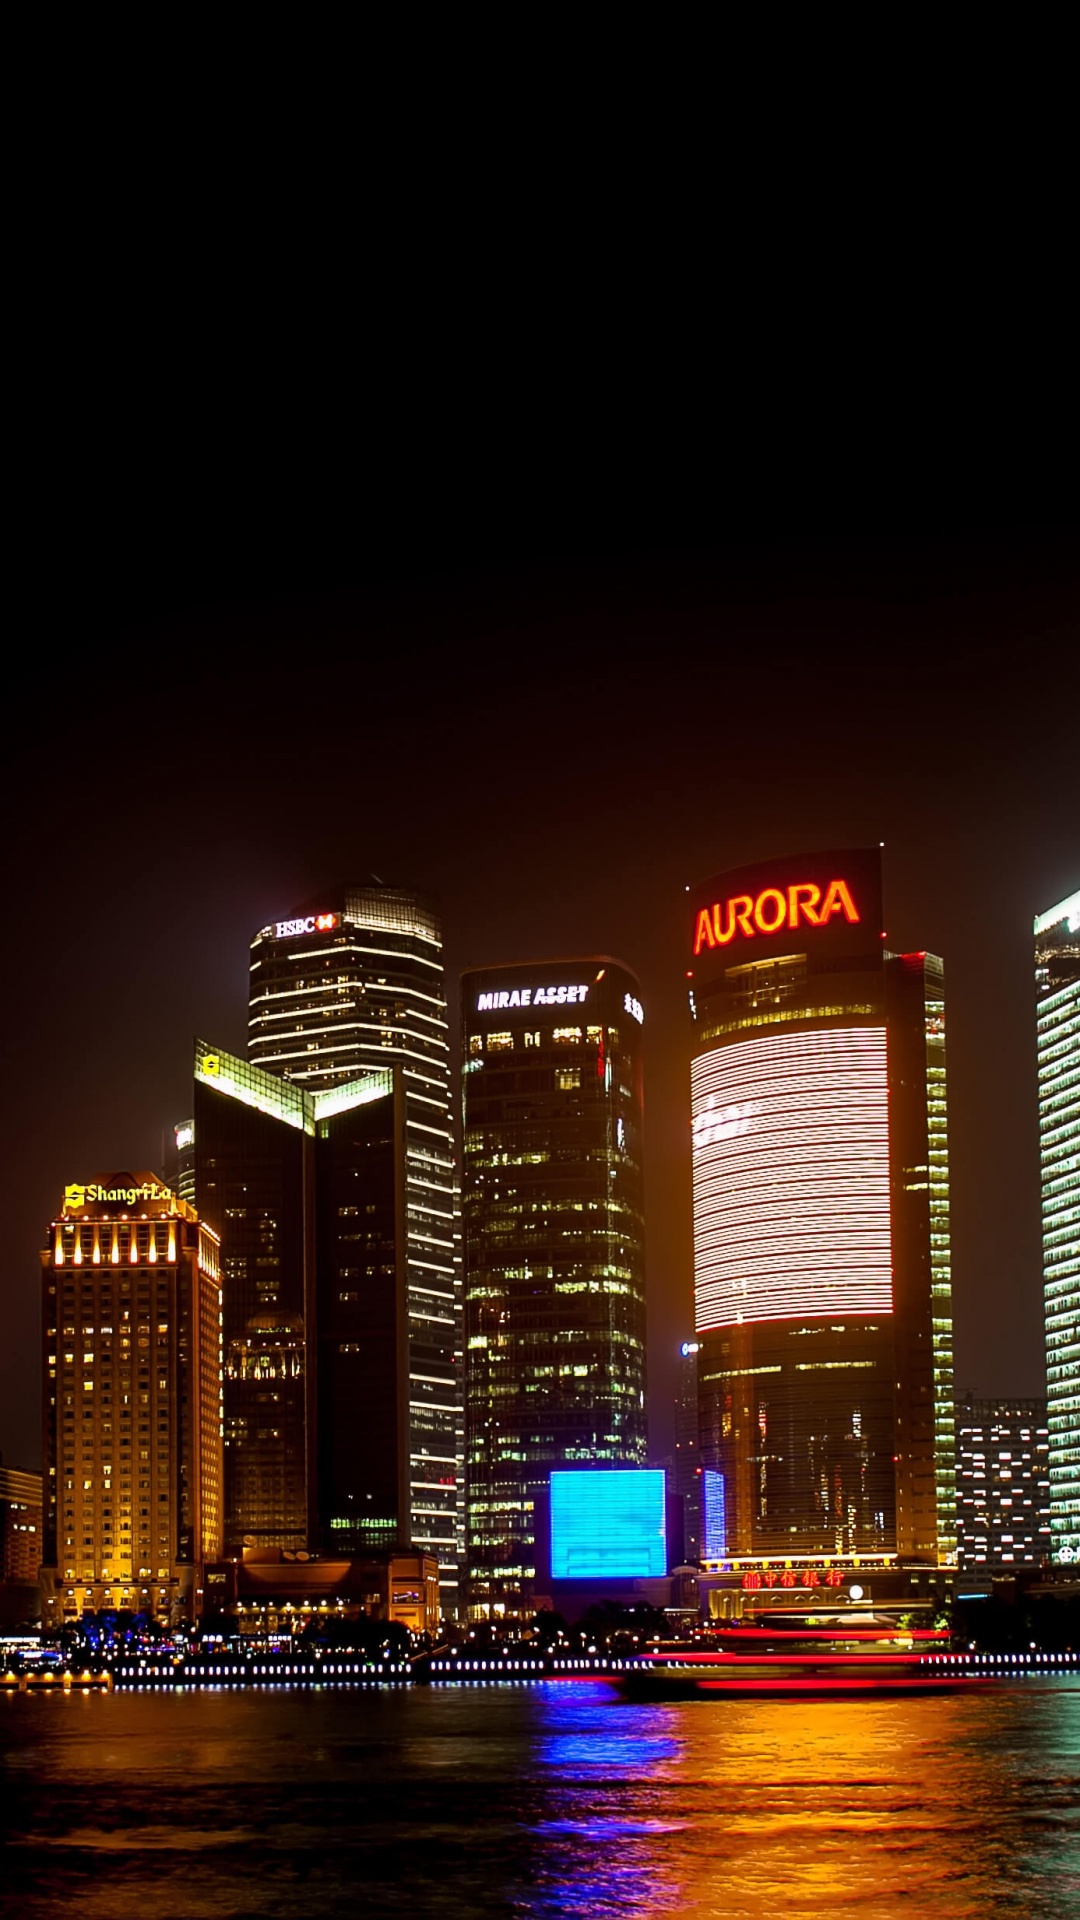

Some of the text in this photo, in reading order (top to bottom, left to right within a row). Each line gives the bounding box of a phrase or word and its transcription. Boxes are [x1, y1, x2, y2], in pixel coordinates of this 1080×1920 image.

[275, 917, 315, 938] HSBC
[693, 880, 860, 955] AURORA
[478, 985, 589, 1011] MIRAE ASSET
[86, 1183, 172, 1205] Shangri-La
